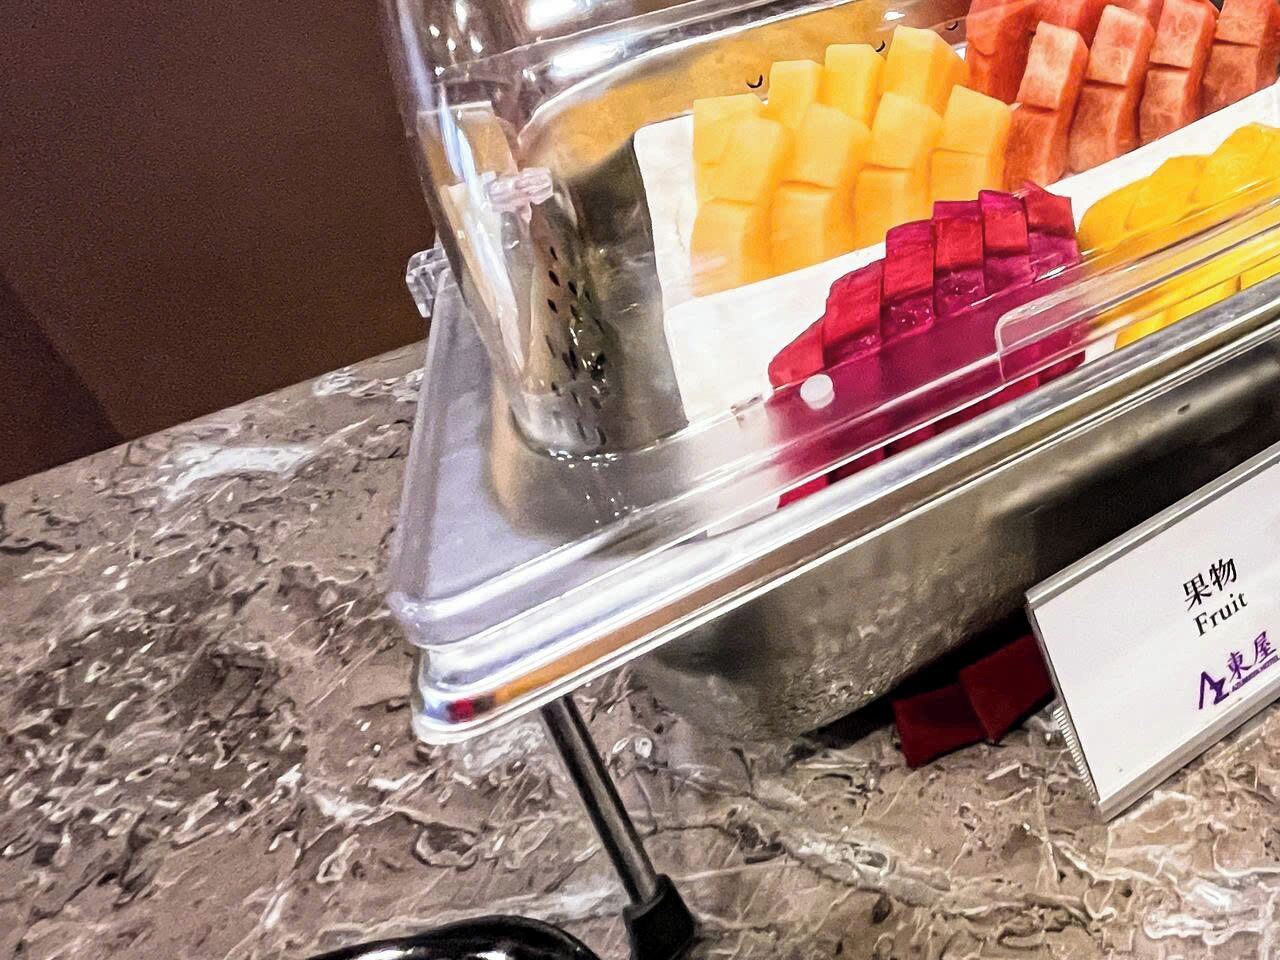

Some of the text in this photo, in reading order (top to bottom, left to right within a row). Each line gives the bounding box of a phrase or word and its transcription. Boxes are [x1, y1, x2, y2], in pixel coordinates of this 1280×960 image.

[1182, 557, 1239, 612] 果物
[1193, 593, 1248, 637] Fruit
[1227, 631, 1278, 683] 東屋
